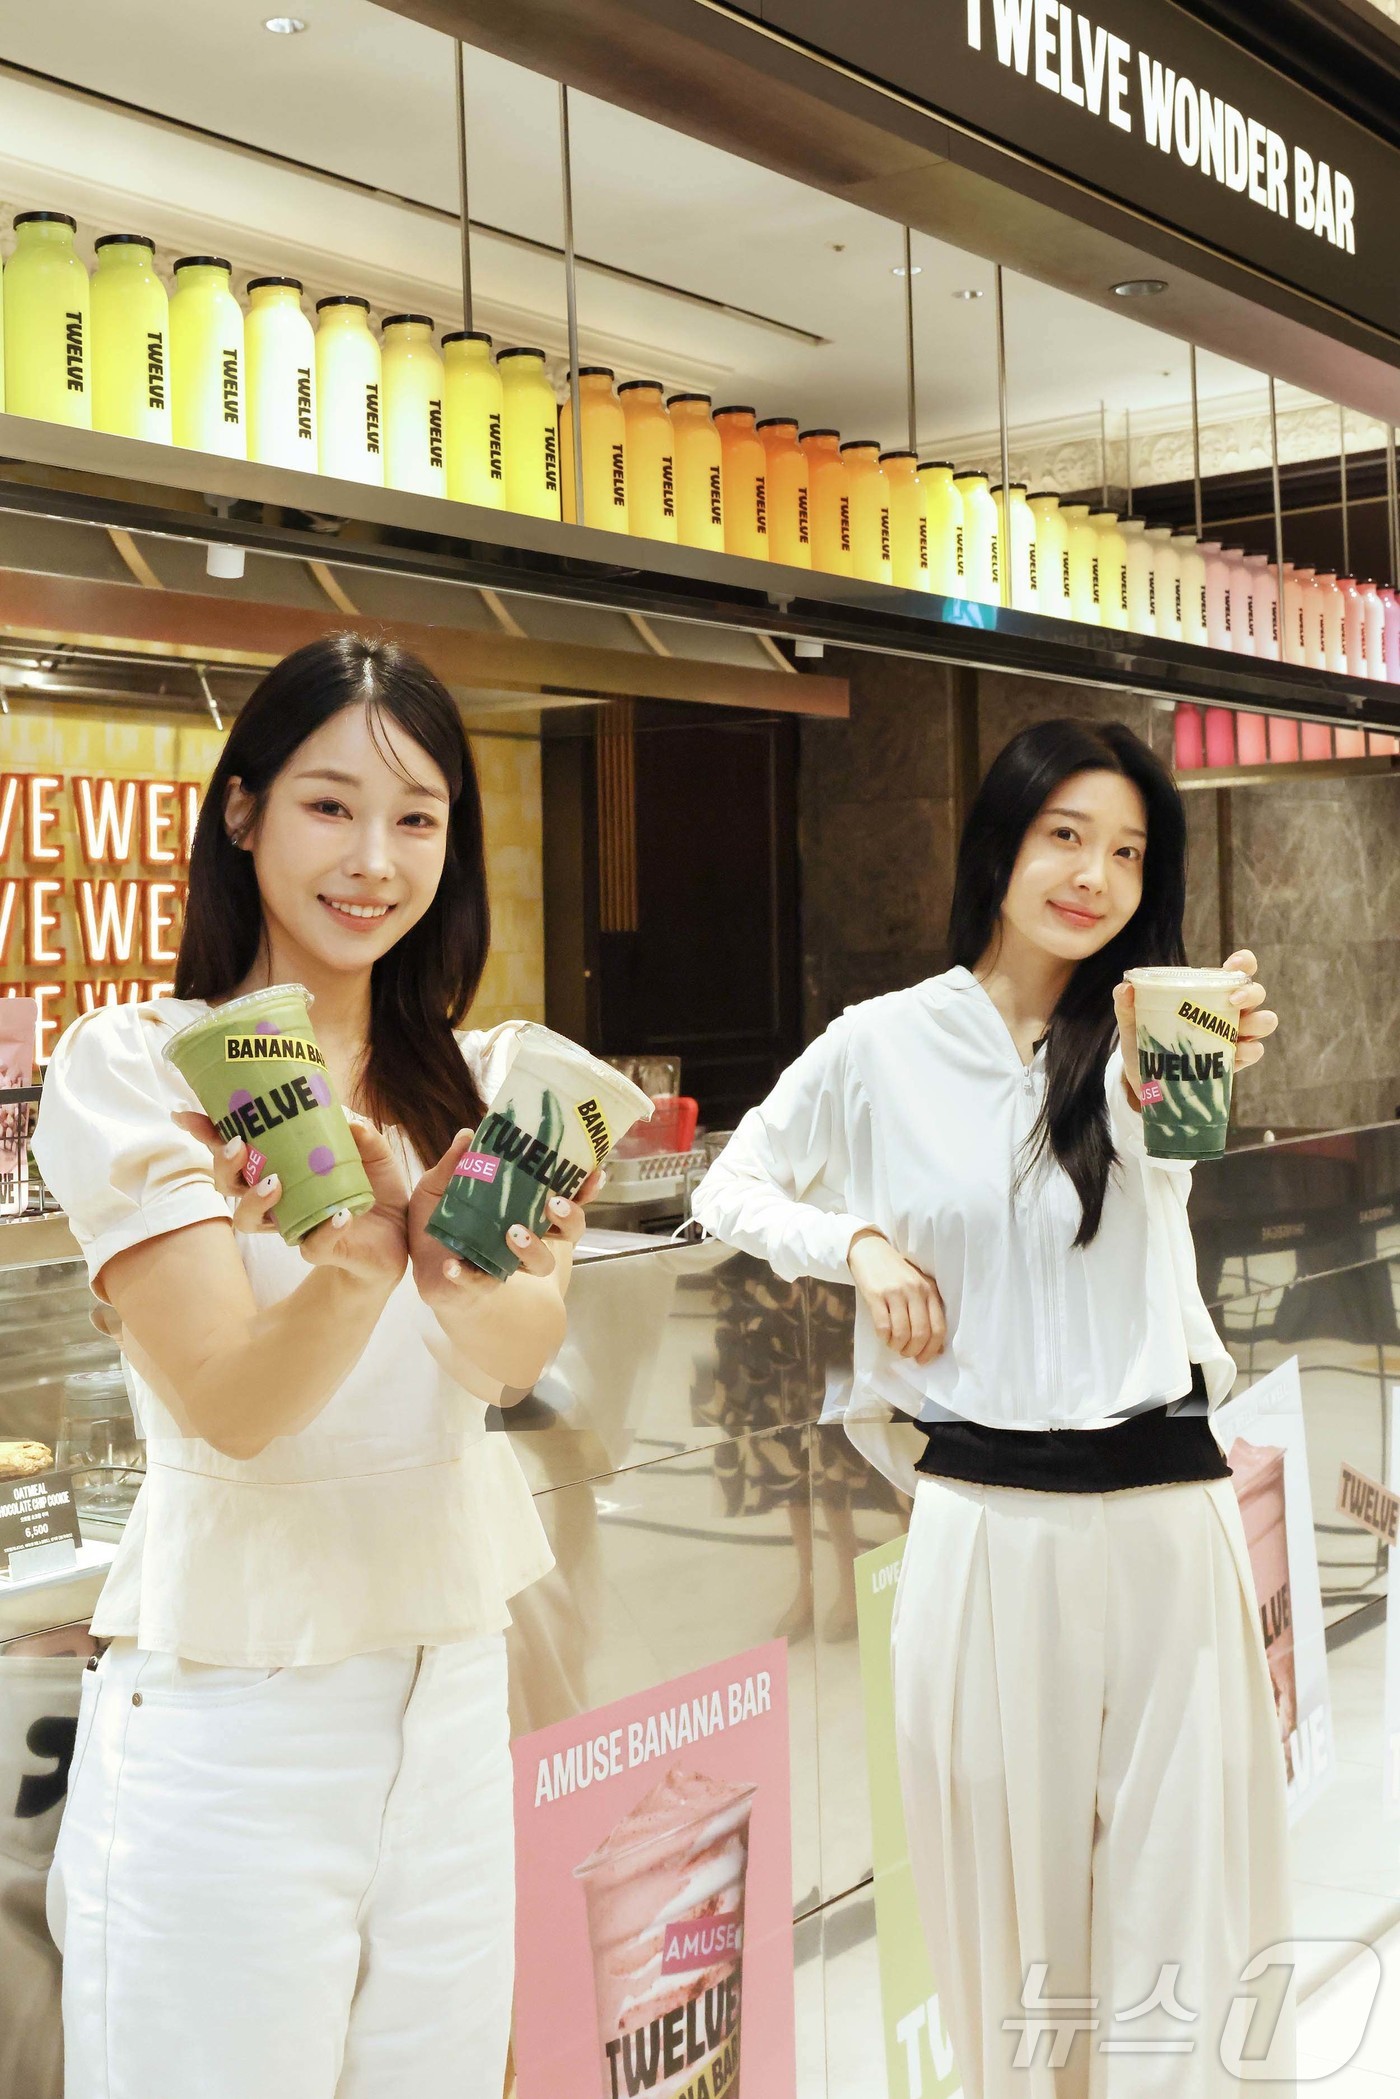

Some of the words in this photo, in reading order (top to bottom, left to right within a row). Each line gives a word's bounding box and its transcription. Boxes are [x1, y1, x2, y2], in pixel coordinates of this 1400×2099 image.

[1137, 51, 1290, 219] WONDER
[1294, 145, 1357, 256] BAR
[65, 312, 84, 392] TWELVE
[147, 332, 164, 410] TWELVE
[222, 349, 239, 424] TWELVE
[297, 368, 312, 440] TWELVE
[365, 384, 380, 454] TWELVE
[429, 400, 443, 468] TWELVE
[488, 414, 502, 481] TWELVE
[544, 426, 558, 492] TWELVE
[611, 444, 625, 507] TWELVE
[661, 456, 674, 518] TWELVE
[710, 466, 722, 525] TWELVE
[756, 476, 767, 535] TWELVE
[798, 487, 809, 544] TWELVE
[840, 497, 850, 551] TWELVE
[881, 507, 890, 561] TWELVE
[919, 517, 928, 569] TWELVE
[956, 526, 964, 576] TWELVE
[1029, 543, 1037, 590] TWELVE
[1092, 557, 1100, 604] TWELVE
[227, 1038, 307, 1060] BANANA
[1177, 1001, 1231, 1040] BANANA
[481, 1112, 588, 1200] TWELVE
[13, 1482, 48, 1500] OATMEAL
[31, 1496, 47, 1511] CHIP
[47, 1490, 71, 1507] COOKIE
[1340, 1469, 1400, 1538] TWELVE
[24, 1523, 49, 1539] 6,500
[534, 1728, 623, 1807] AMUSE
[628, 1690, 725, 1769] BANANA
[728, 1671, 771, 1727] BAR
[665, 1923, 737, 1962] AMUSE
[605, 1970, 742, 2099] TWELVE
